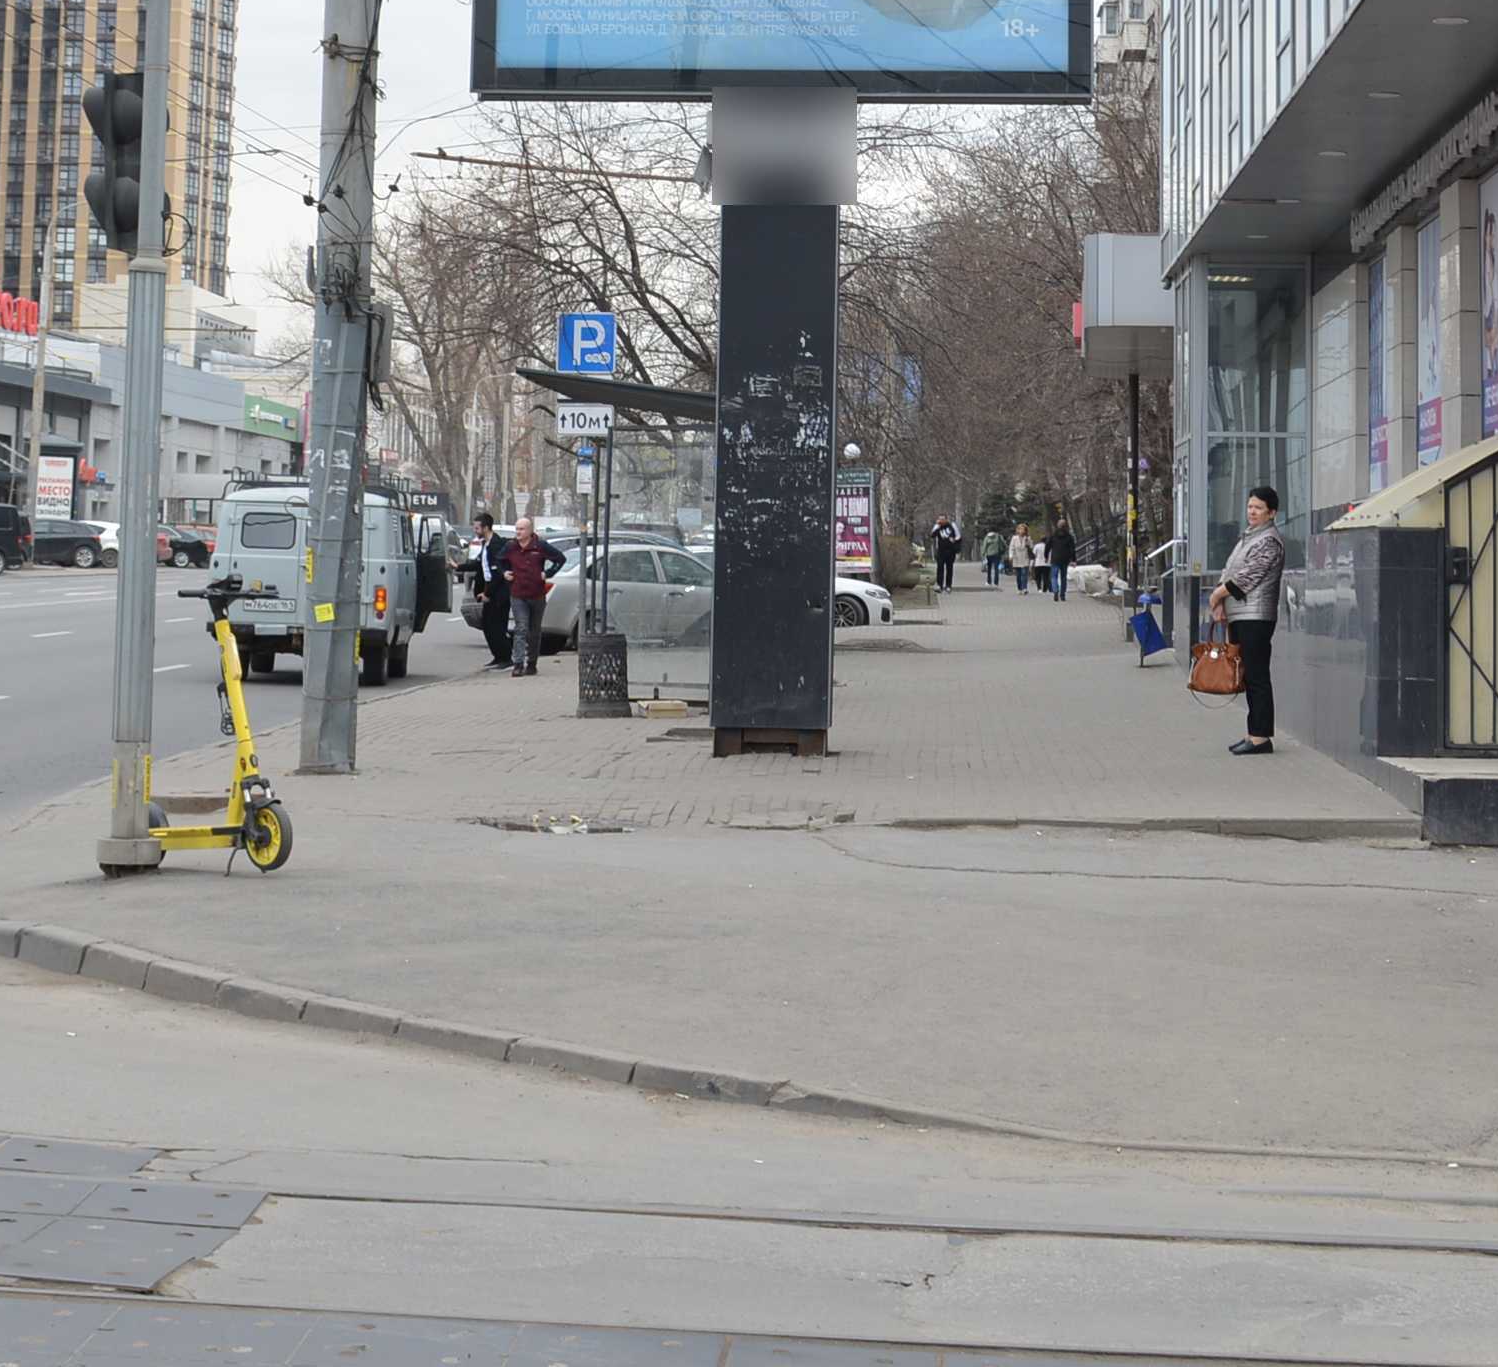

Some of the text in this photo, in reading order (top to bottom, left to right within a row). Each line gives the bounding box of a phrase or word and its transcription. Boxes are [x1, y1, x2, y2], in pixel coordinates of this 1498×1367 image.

[1001, 18, 1039, 38] 18+
[38, 486, 71, 496] МЕСТО
[36, 496, 70, 506] ВИДНО
[412, 494, 438, 505] ЕТЫ
